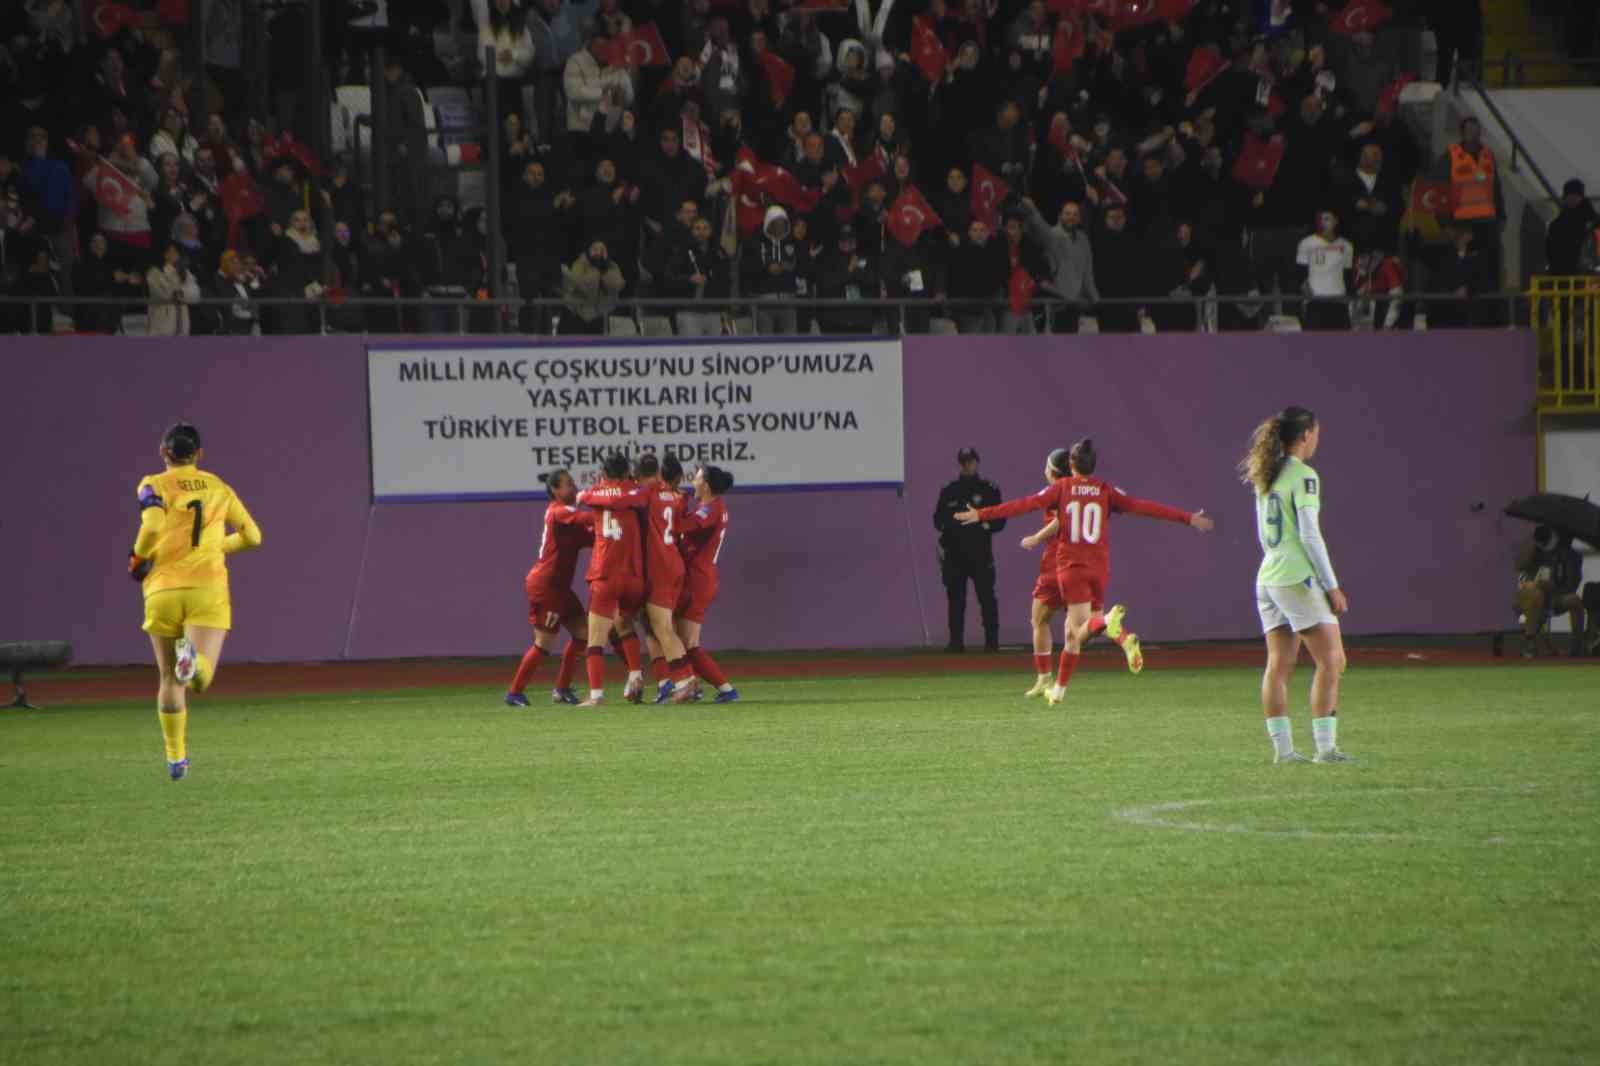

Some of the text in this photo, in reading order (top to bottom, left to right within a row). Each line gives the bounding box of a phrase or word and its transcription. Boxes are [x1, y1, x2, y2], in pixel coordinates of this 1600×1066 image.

[399, 356, 465, 381] MİLLİ
[473, 359, 528, 384] MAÇ
[528, 380, 752, 412] YAŞATTIKLARI İÇİN
[424, 414, 528, 439] TÜRKİYE
[535, 416, 630, 437] FUTBOL
[186, 499, 204, 547] 1
[602, 509, 622, 541] 4
[663, 506, 674, 545] 2
[1065, 500, 1102, 545] 10
[1266, 492, 1284, 549] 9
